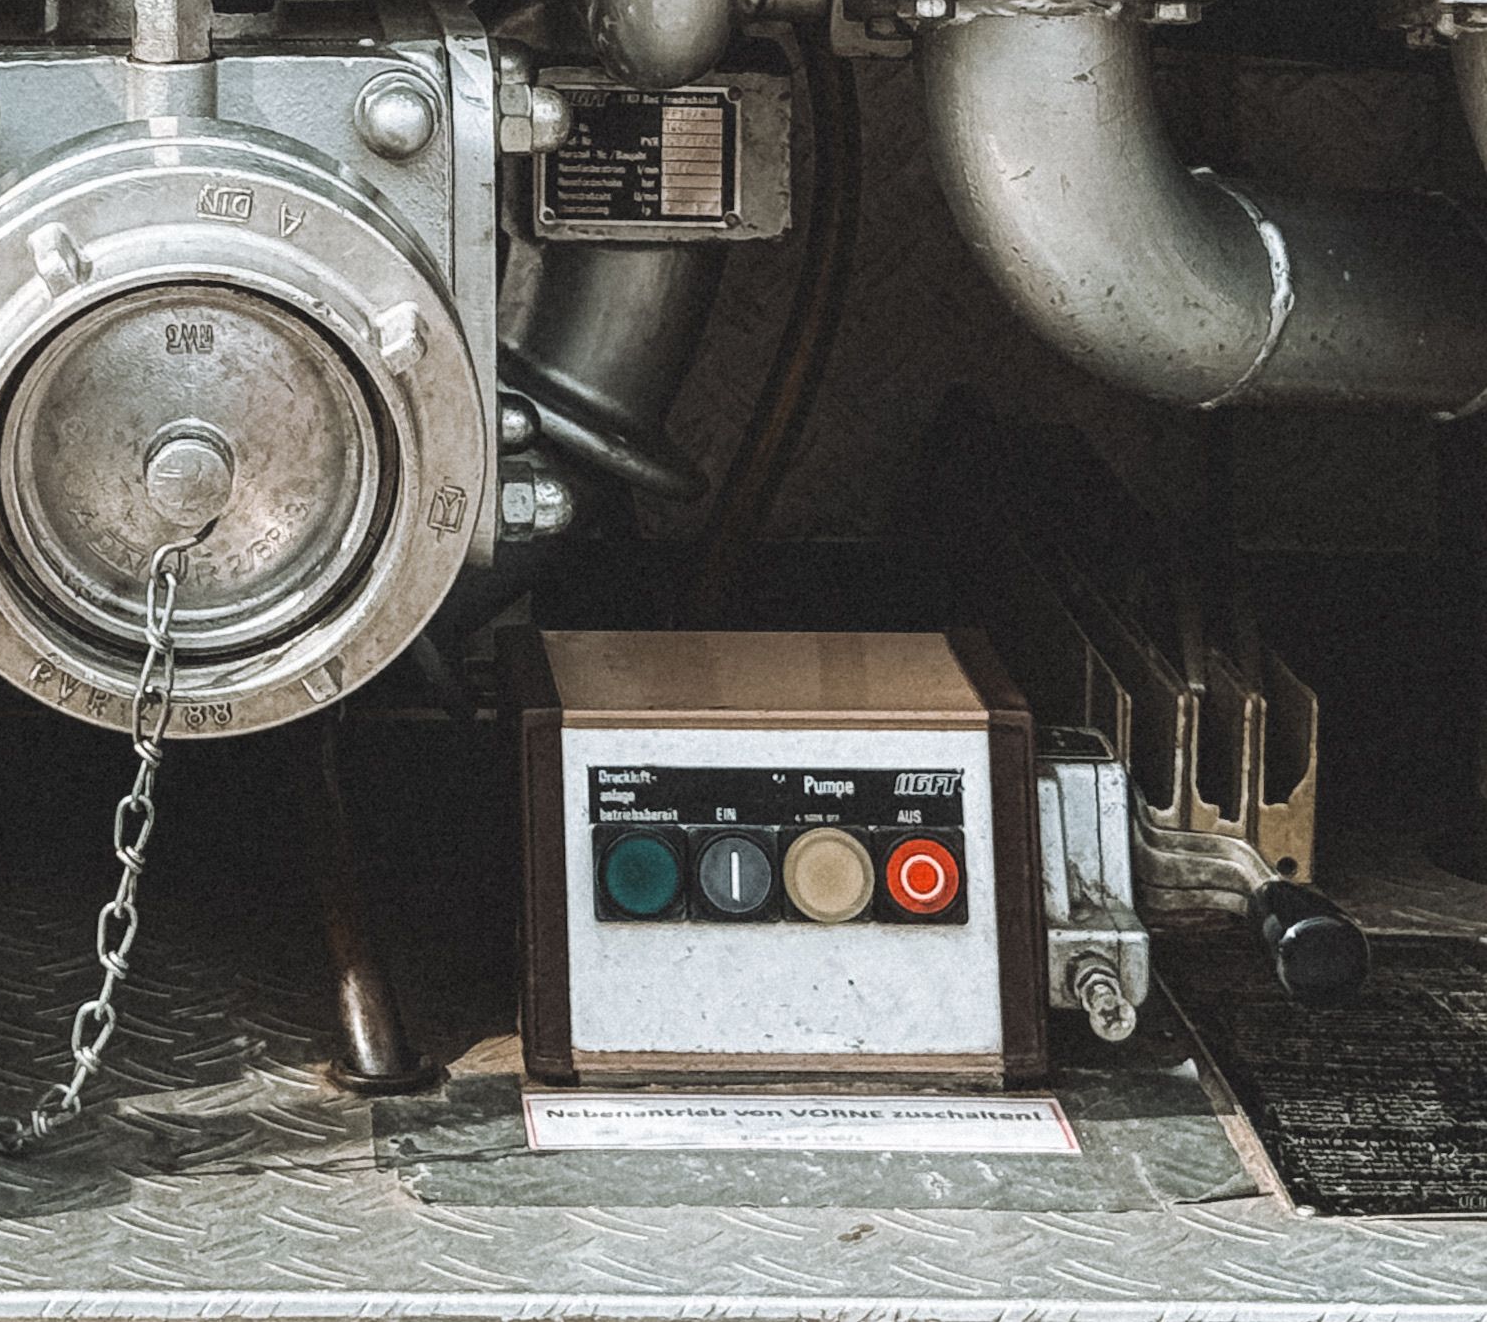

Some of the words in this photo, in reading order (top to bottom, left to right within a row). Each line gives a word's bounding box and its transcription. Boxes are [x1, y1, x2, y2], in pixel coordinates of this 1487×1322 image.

[197, 183, 254, 222] DIN
[803, 775, 855, 799] Pumpe
[715, 807, 737, 821] EIN
[897, 809, 922, 824] AUS
[546, 1106, 727, 1119] Nebenantrieb
[734, 1108, 783, 1118] von
[789, 1108, 884, 1120] VORNE
